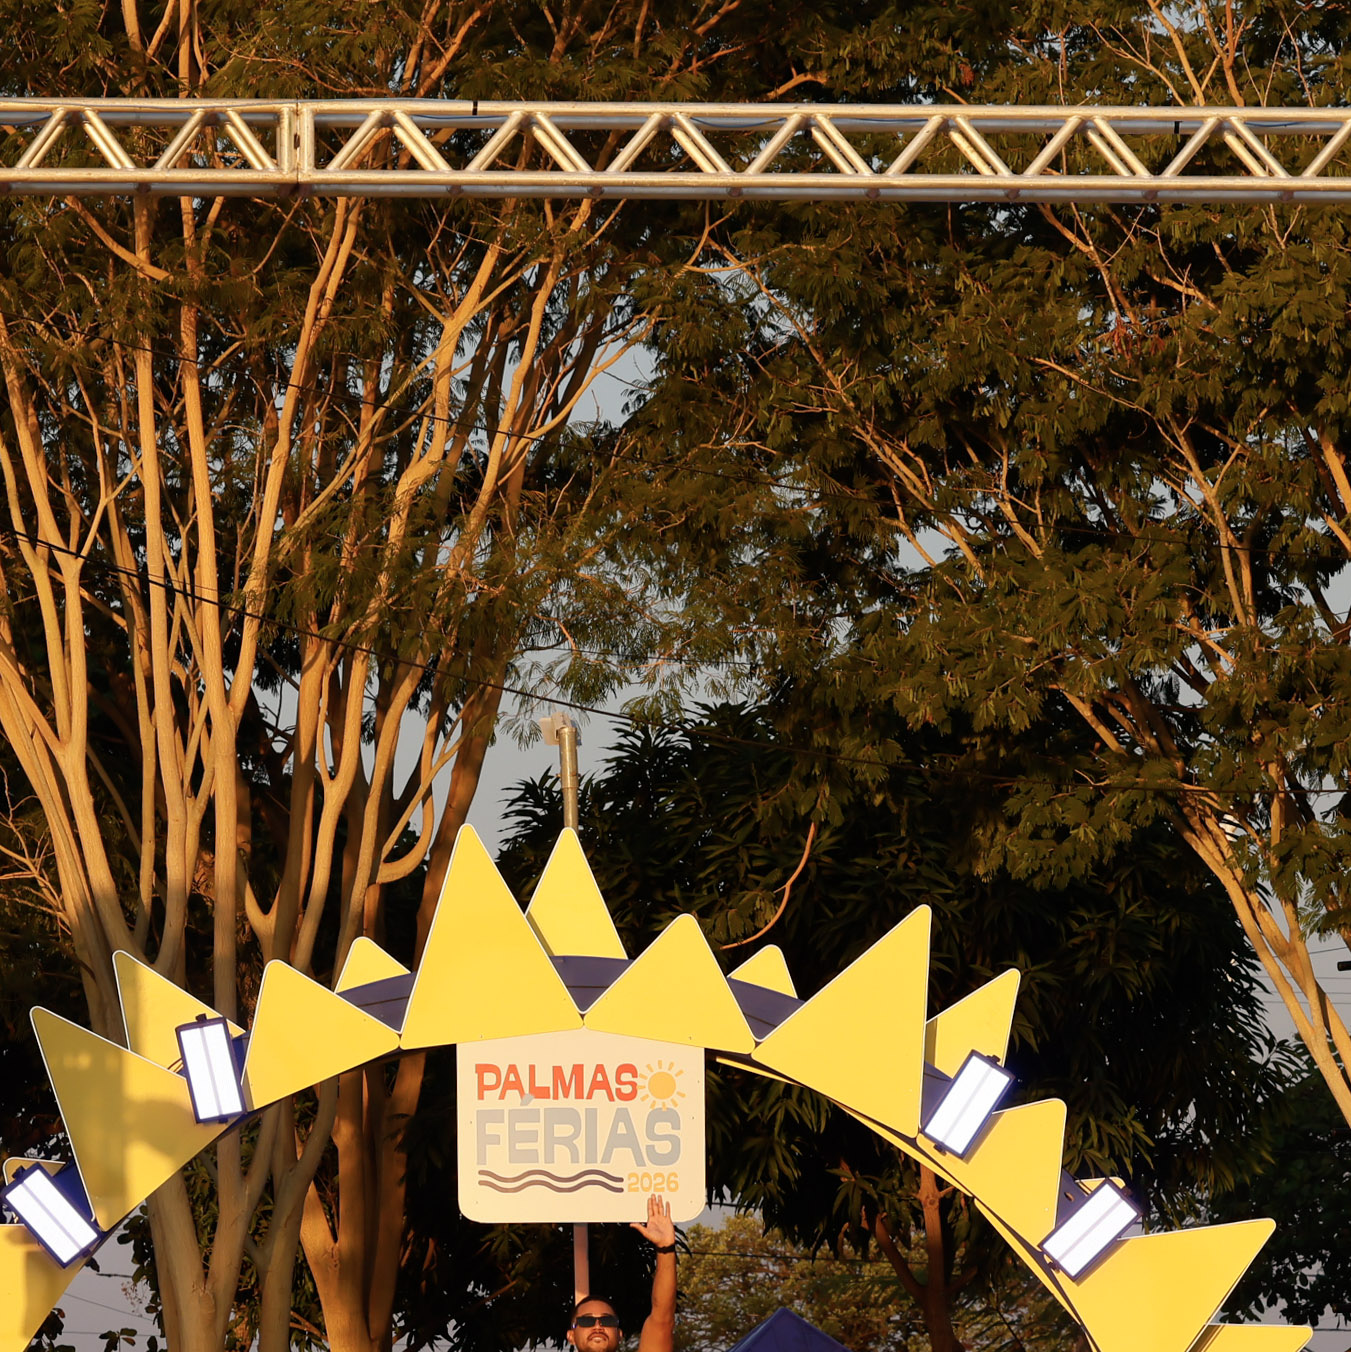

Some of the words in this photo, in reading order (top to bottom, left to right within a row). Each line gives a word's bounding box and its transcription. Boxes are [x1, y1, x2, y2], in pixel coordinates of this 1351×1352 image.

[475, 1063, 638, 1102] PALMAS
[476, 1093, 681, 1167] FÉRIAS
[627, 1172, 679, 1193] 2026
